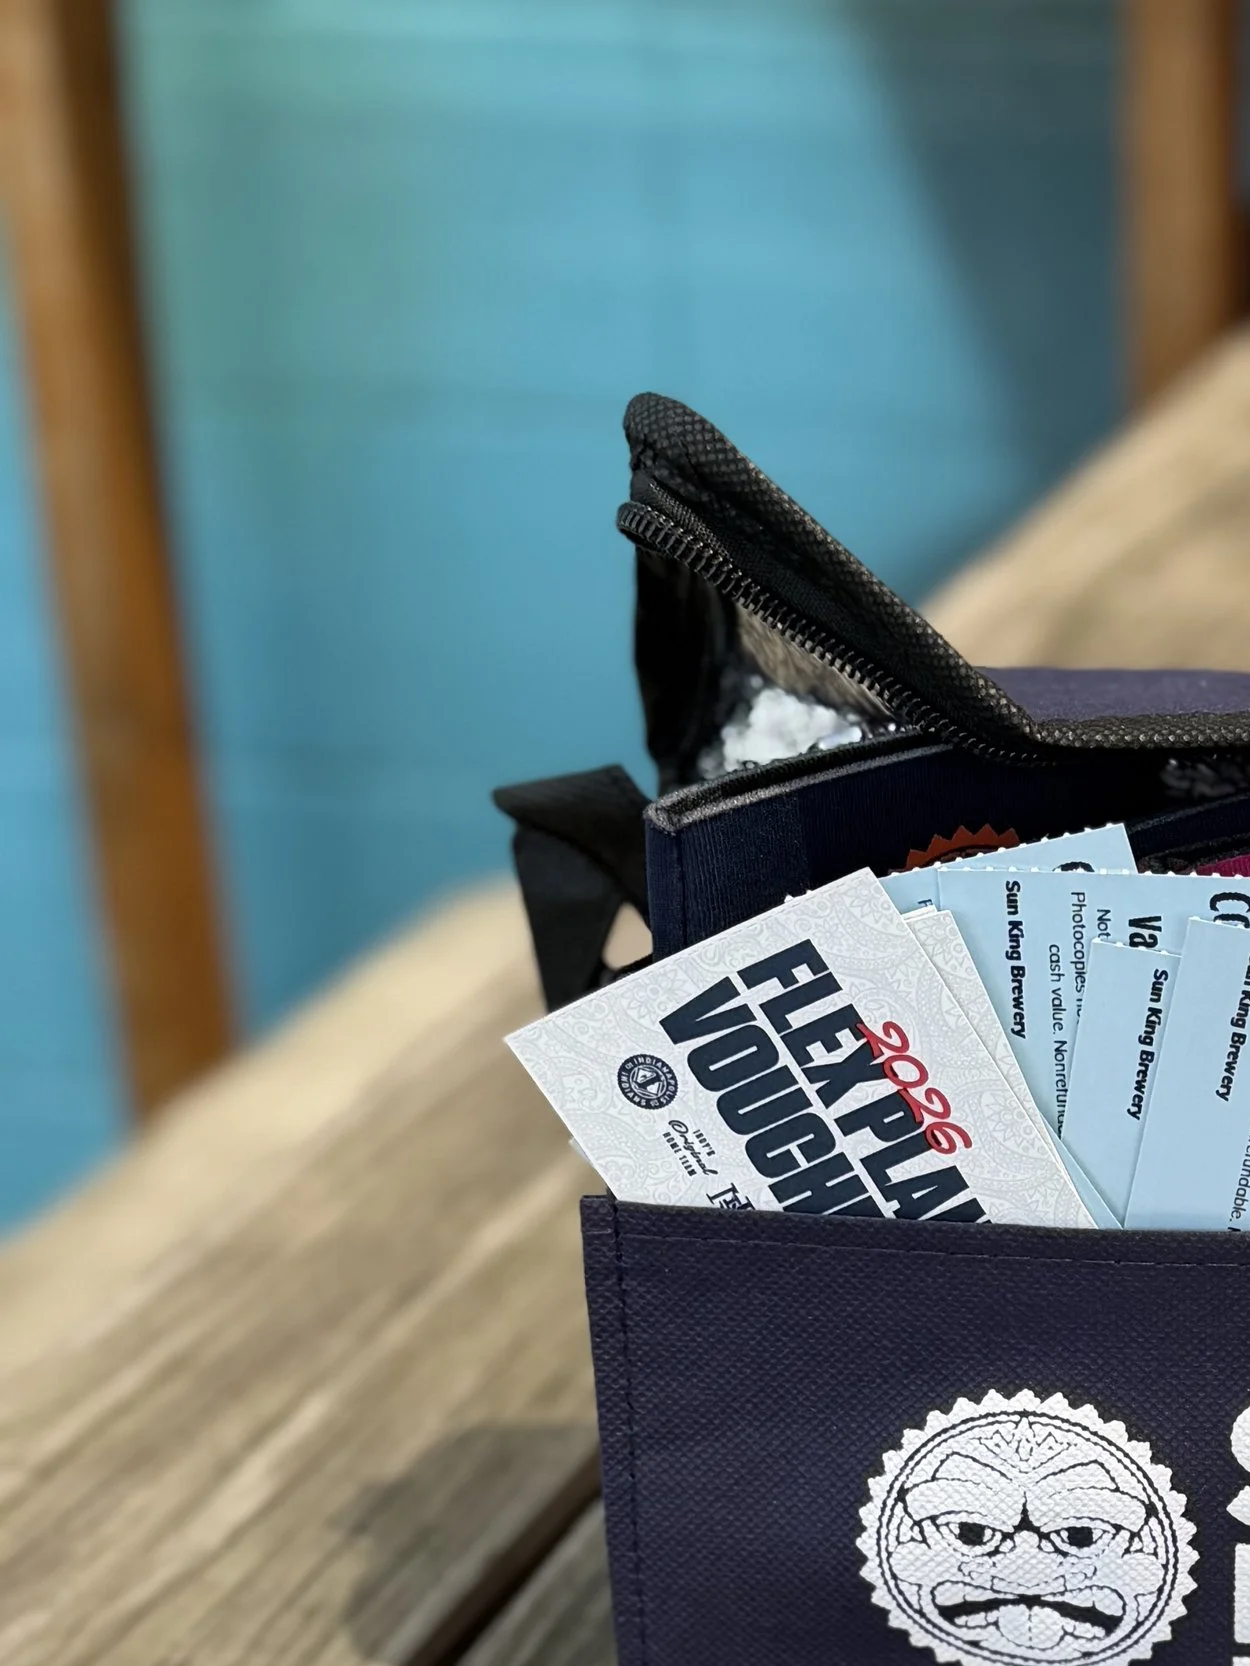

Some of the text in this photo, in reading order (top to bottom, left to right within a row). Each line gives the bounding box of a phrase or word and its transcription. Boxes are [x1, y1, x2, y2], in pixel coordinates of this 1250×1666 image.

[1005, 879, 1026, 1039] Sun King Brewery
[1049, 944, 1065, 983] cash
[1070, 891, 1087, 993] Photocopies
[737, 939, 890, 1109] FLEX
[1050, 987, 1067, 1035] value.
[1127, 968, 1169, 1121] Sun King Brewery
[659, 976, 885, 1218] VOUCH
[857, 1021, 972, 1154] 2026
[1215, 1032, 1247, 1102] Brewery
[662, 1131, 697, 1177] HOME TEAM
[668, 1119, 719, 1176] Original
